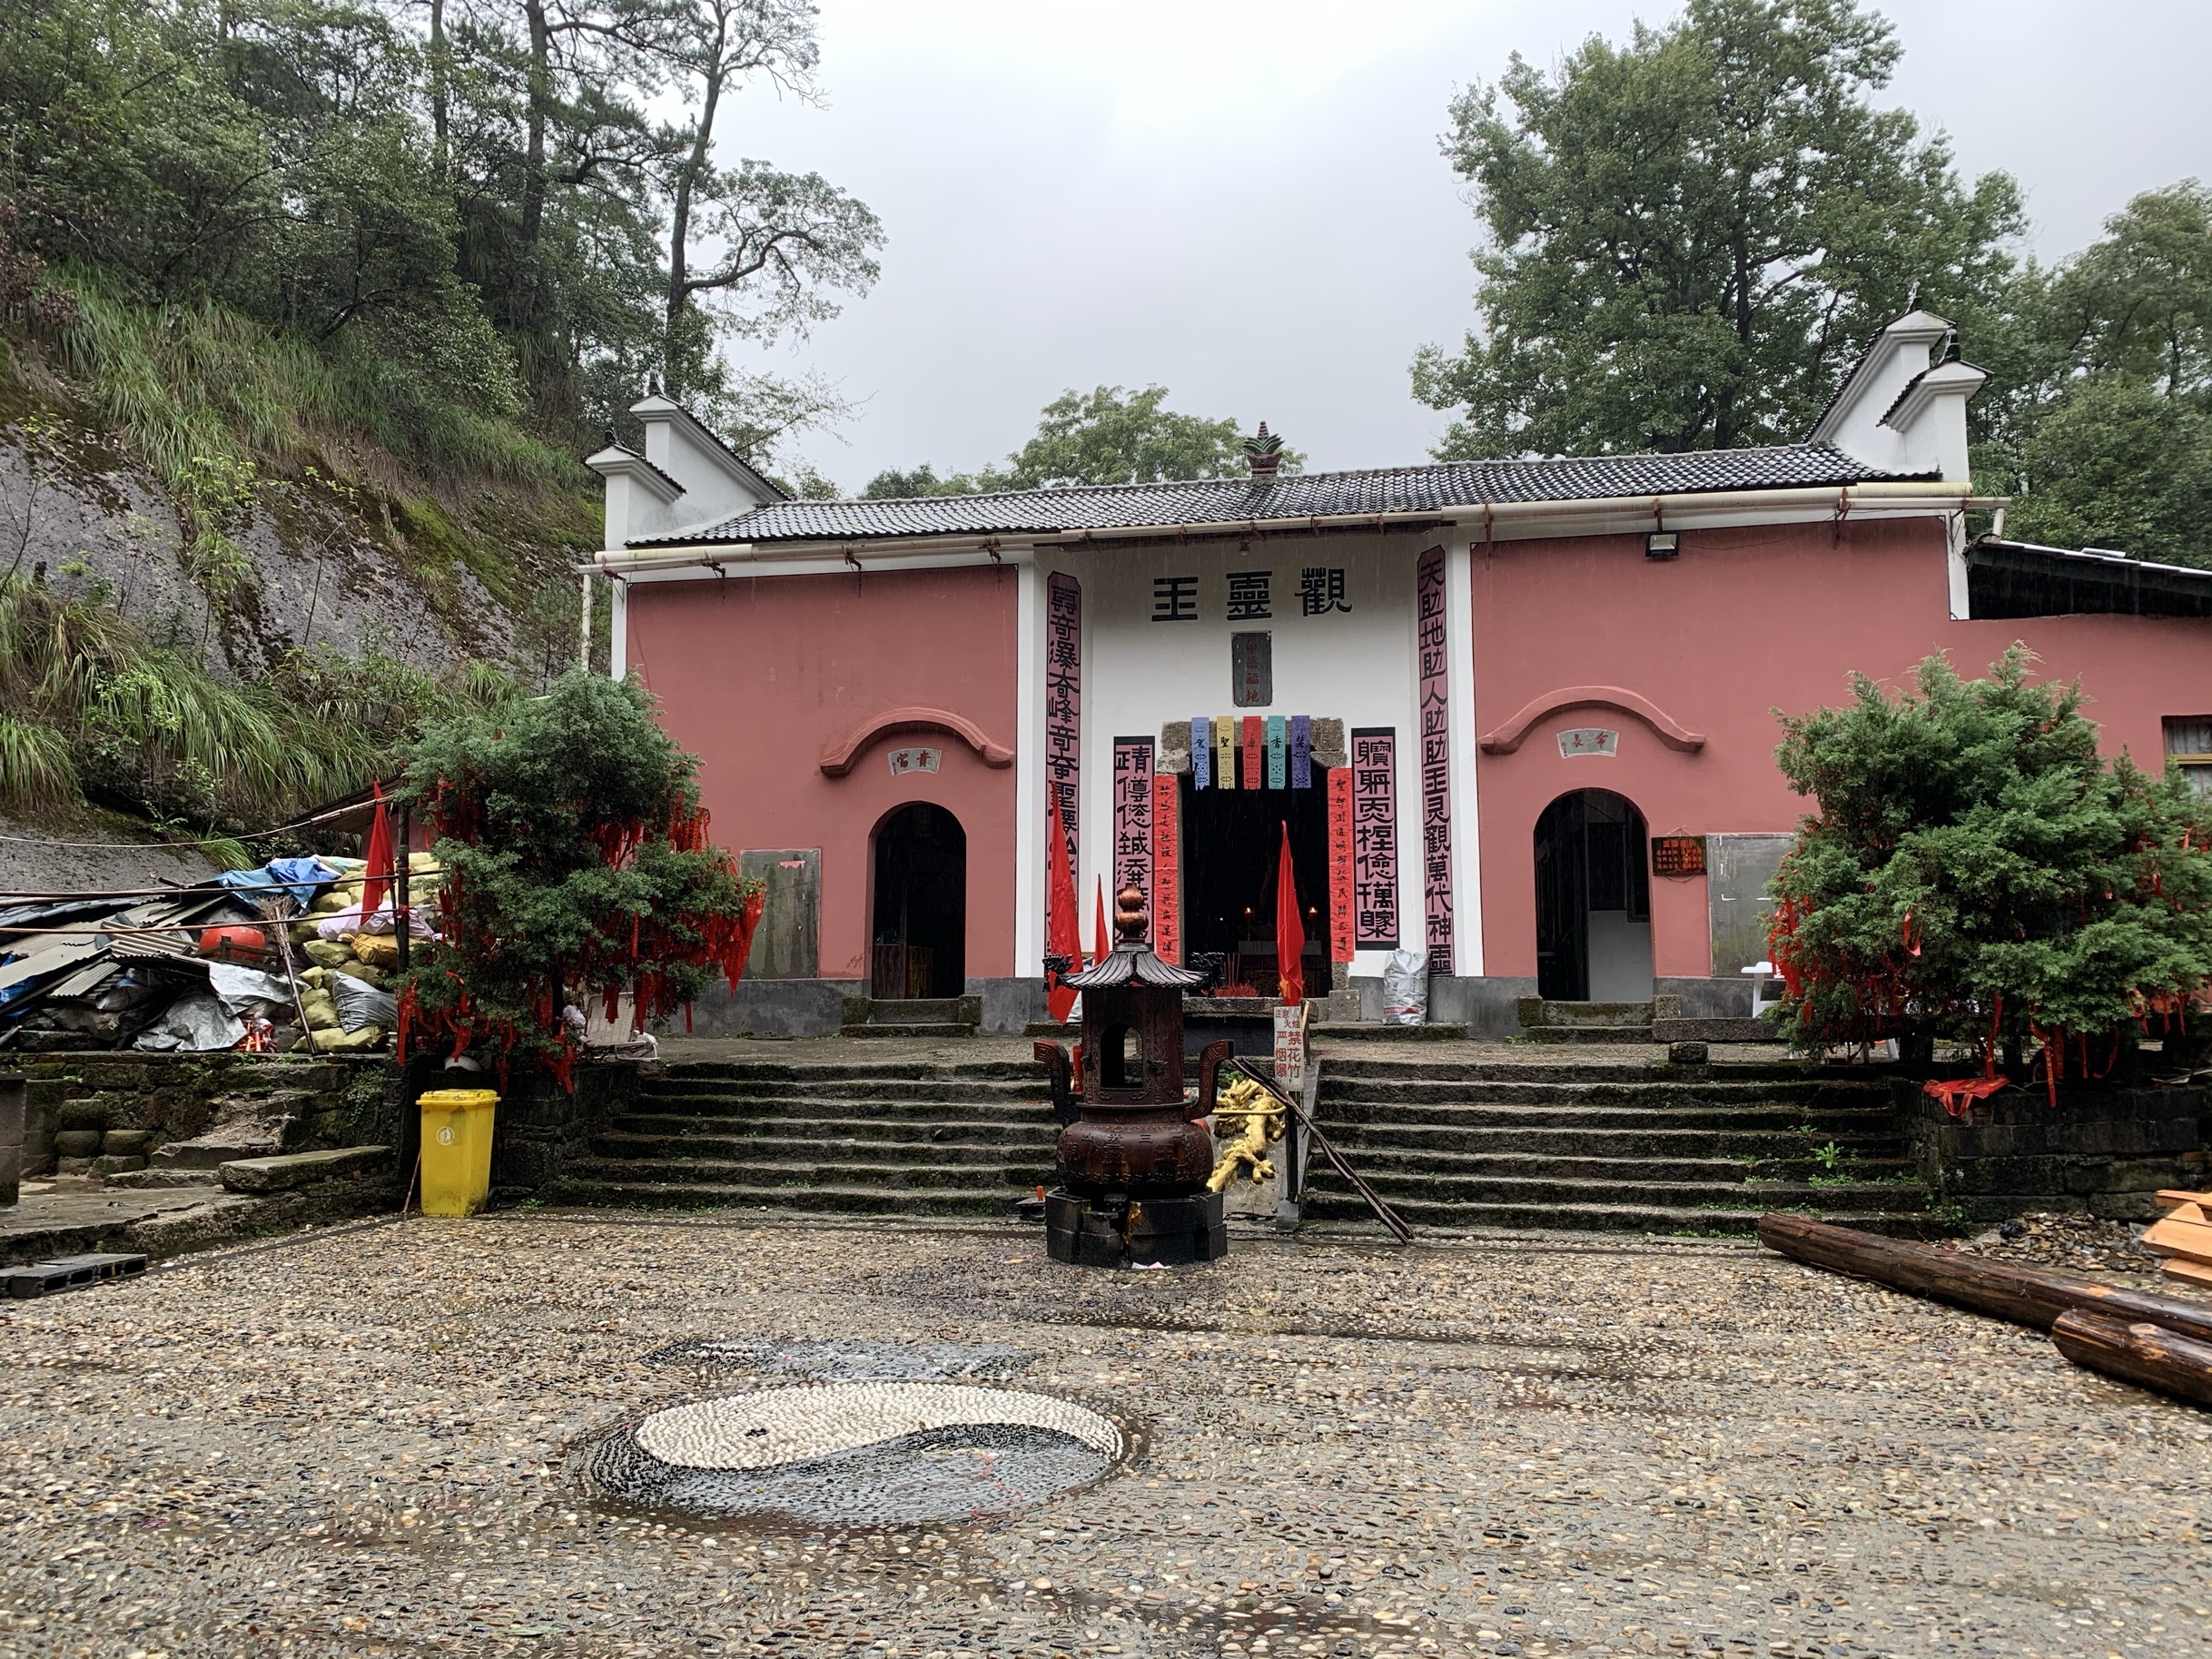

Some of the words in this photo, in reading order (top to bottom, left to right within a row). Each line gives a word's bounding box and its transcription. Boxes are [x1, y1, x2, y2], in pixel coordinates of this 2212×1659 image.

[1572, 731, 1608, 750] 長命
[897, 750, 931, 768] 富貴
[1276, 1031, 1301, 1045] 严禁
[1275, 1047, 1301, 1062] 烟花
[1275, 1062, 1301, 1079] 爆竹
